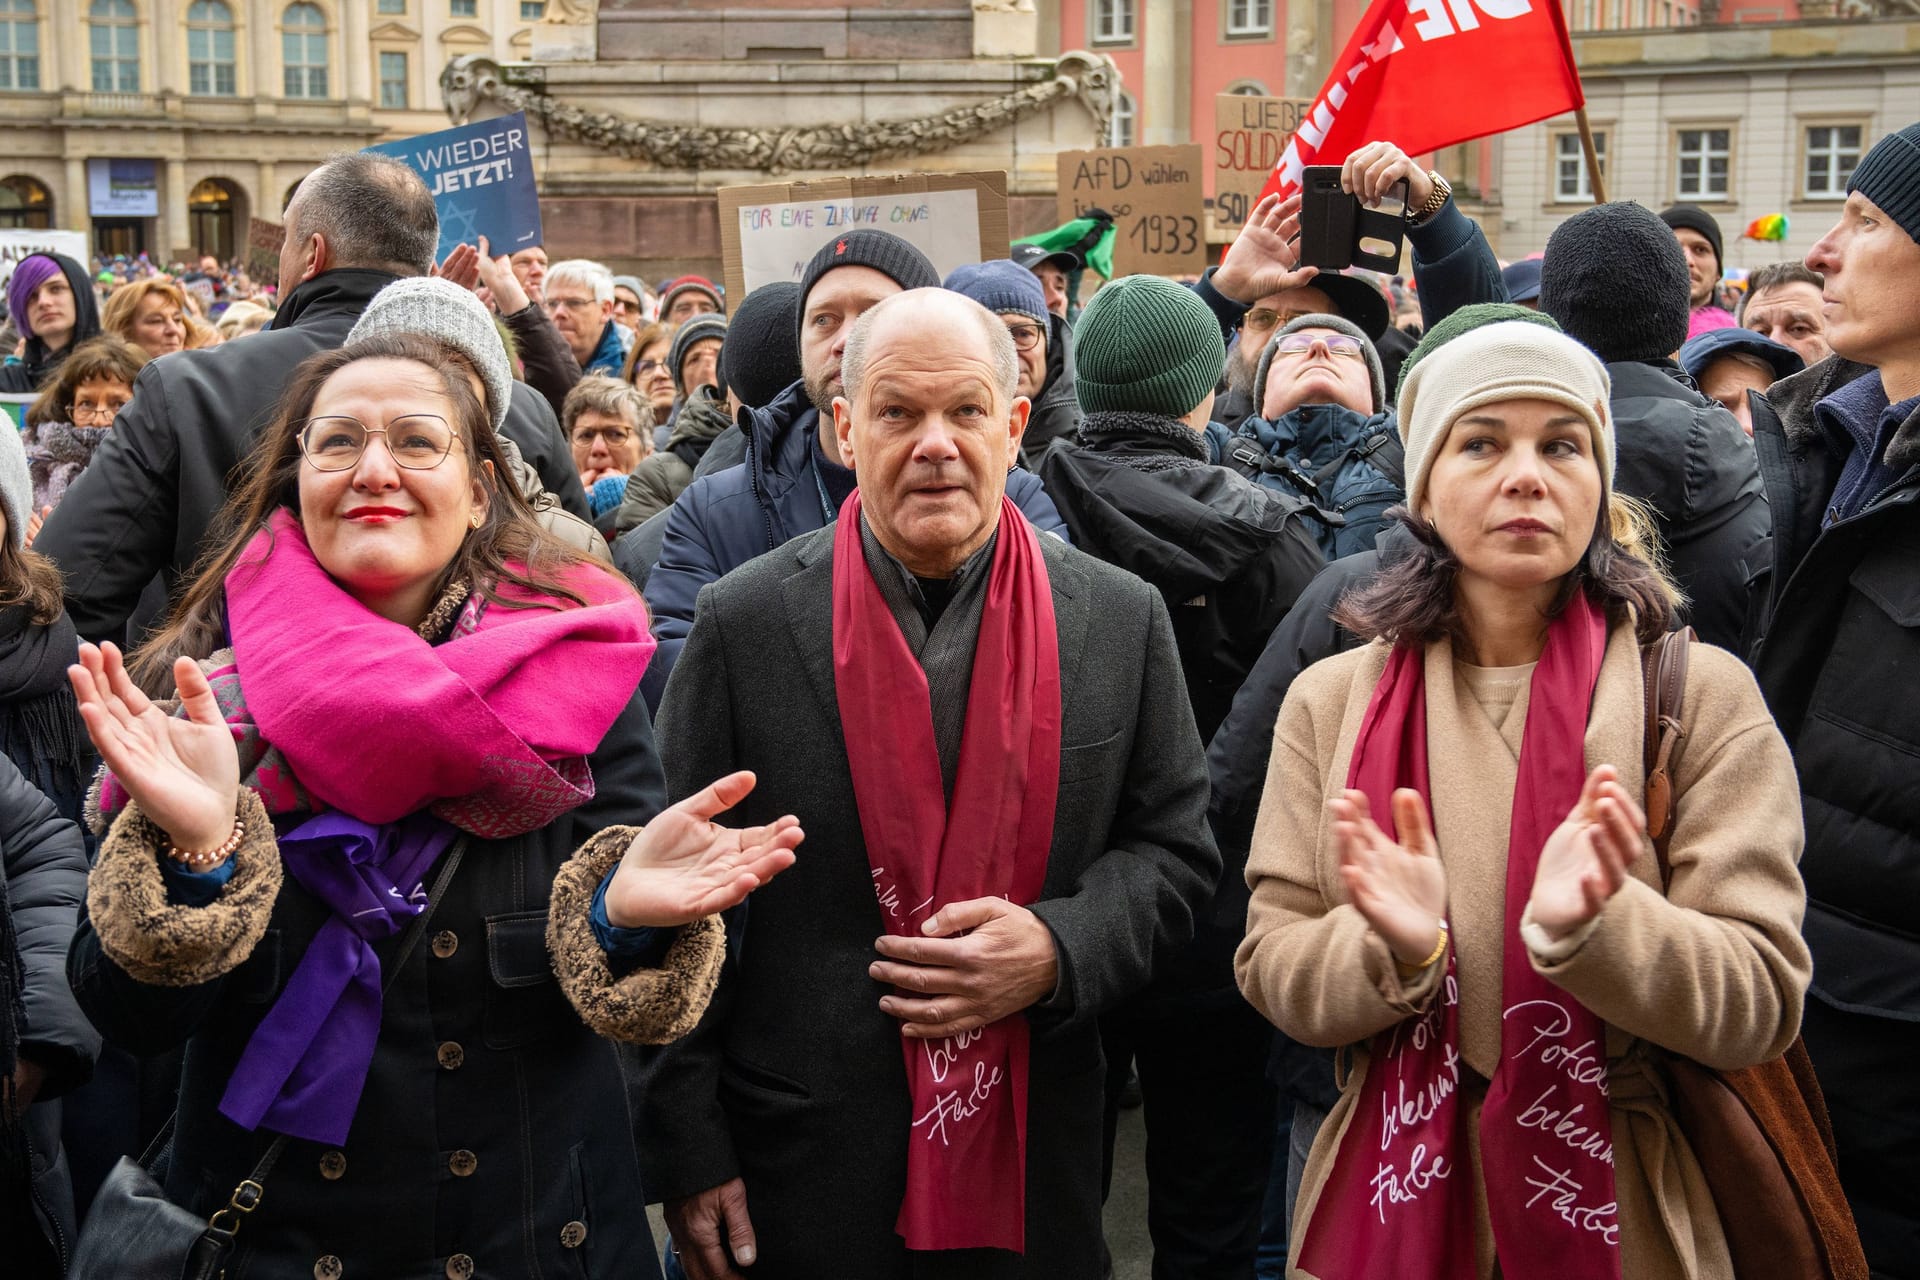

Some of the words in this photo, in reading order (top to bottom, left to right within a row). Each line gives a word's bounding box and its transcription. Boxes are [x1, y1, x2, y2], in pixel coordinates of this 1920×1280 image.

[416, 129, 523, 171] WIEDER
[432, 157, 513, 196] JETZT!
[1073, 155, 1132, 190] AfD
[1140, 162, 1190, 185] wählen
[890, 204, 929, 223] OHNE
[1111, 203, 1132, 218] so
[1129, 215, 1197, 255] 1933
[912, 1060, 1004, 1146] Farbe
[1370, 1143, 1451, 1224] Farbe
[1525, 1155, 1619, 1245] Farbe
